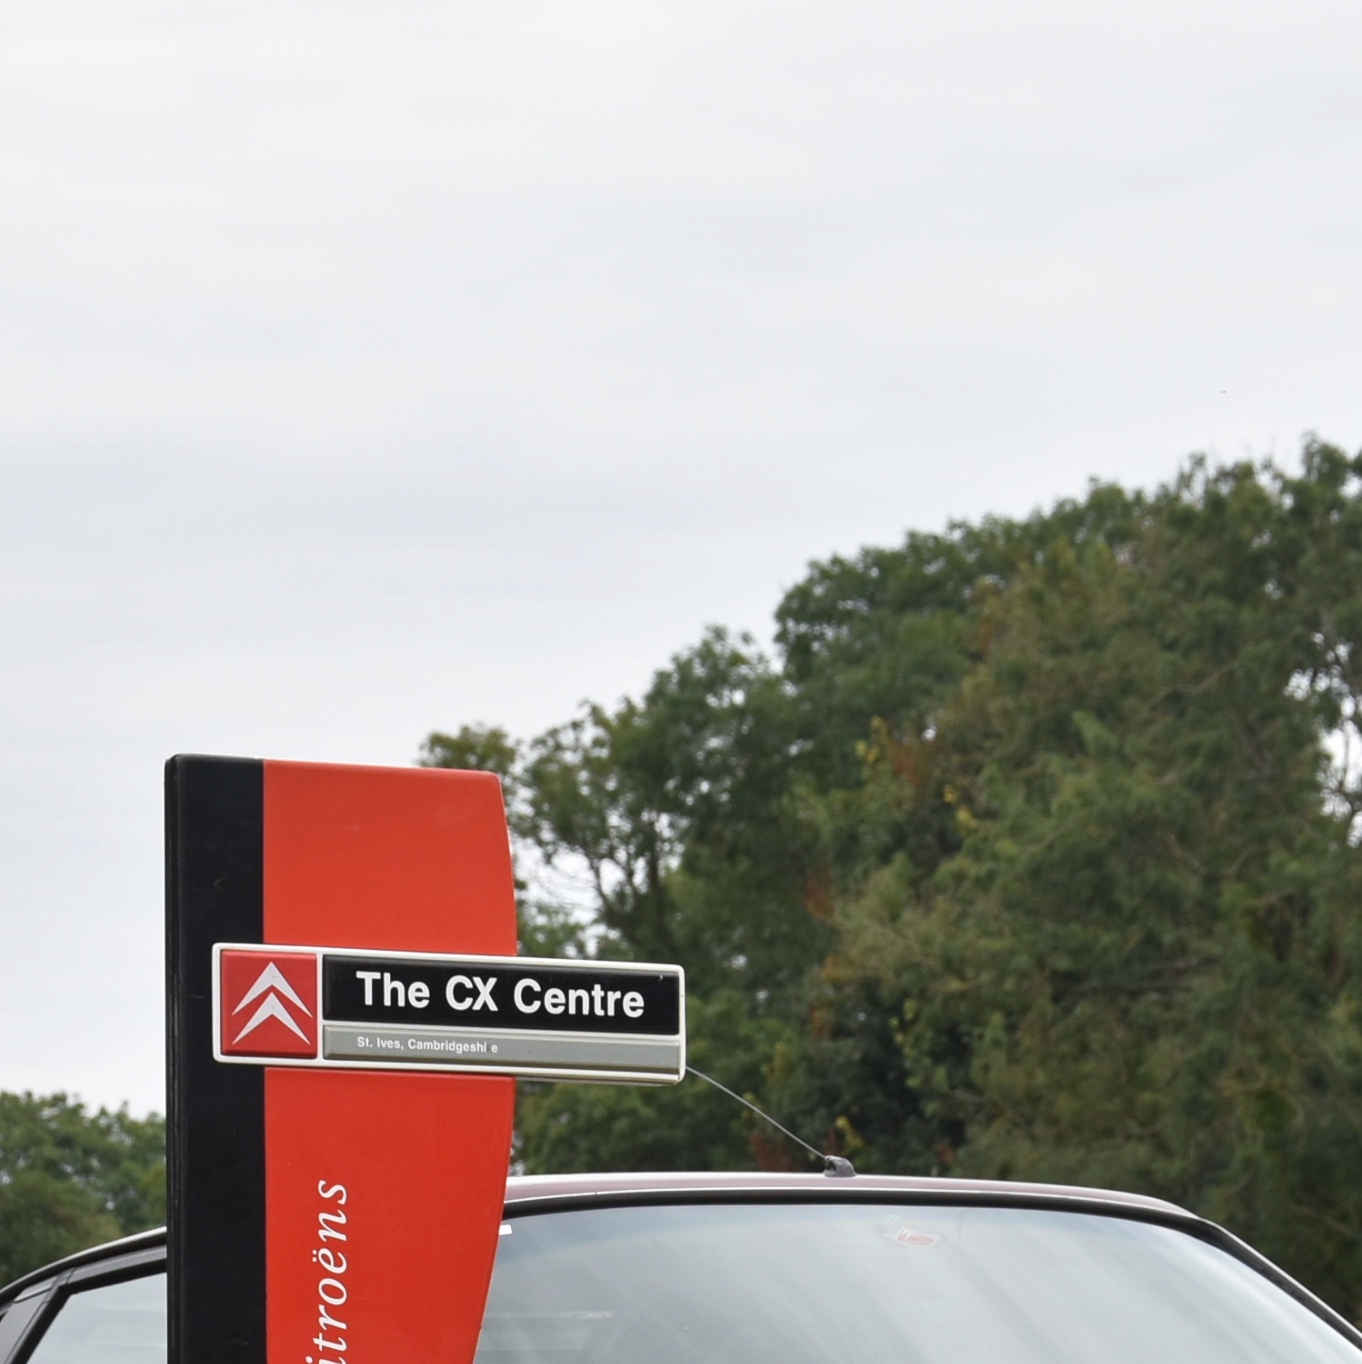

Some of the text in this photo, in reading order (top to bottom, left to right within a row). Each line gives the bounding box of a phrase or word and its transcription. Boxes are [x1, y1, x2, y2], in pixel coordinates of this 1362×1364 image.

[355, 970, 646, 1019] The CX Centre
[357, 1035, 499, 1055] St. Ives, Cambridgeshie
